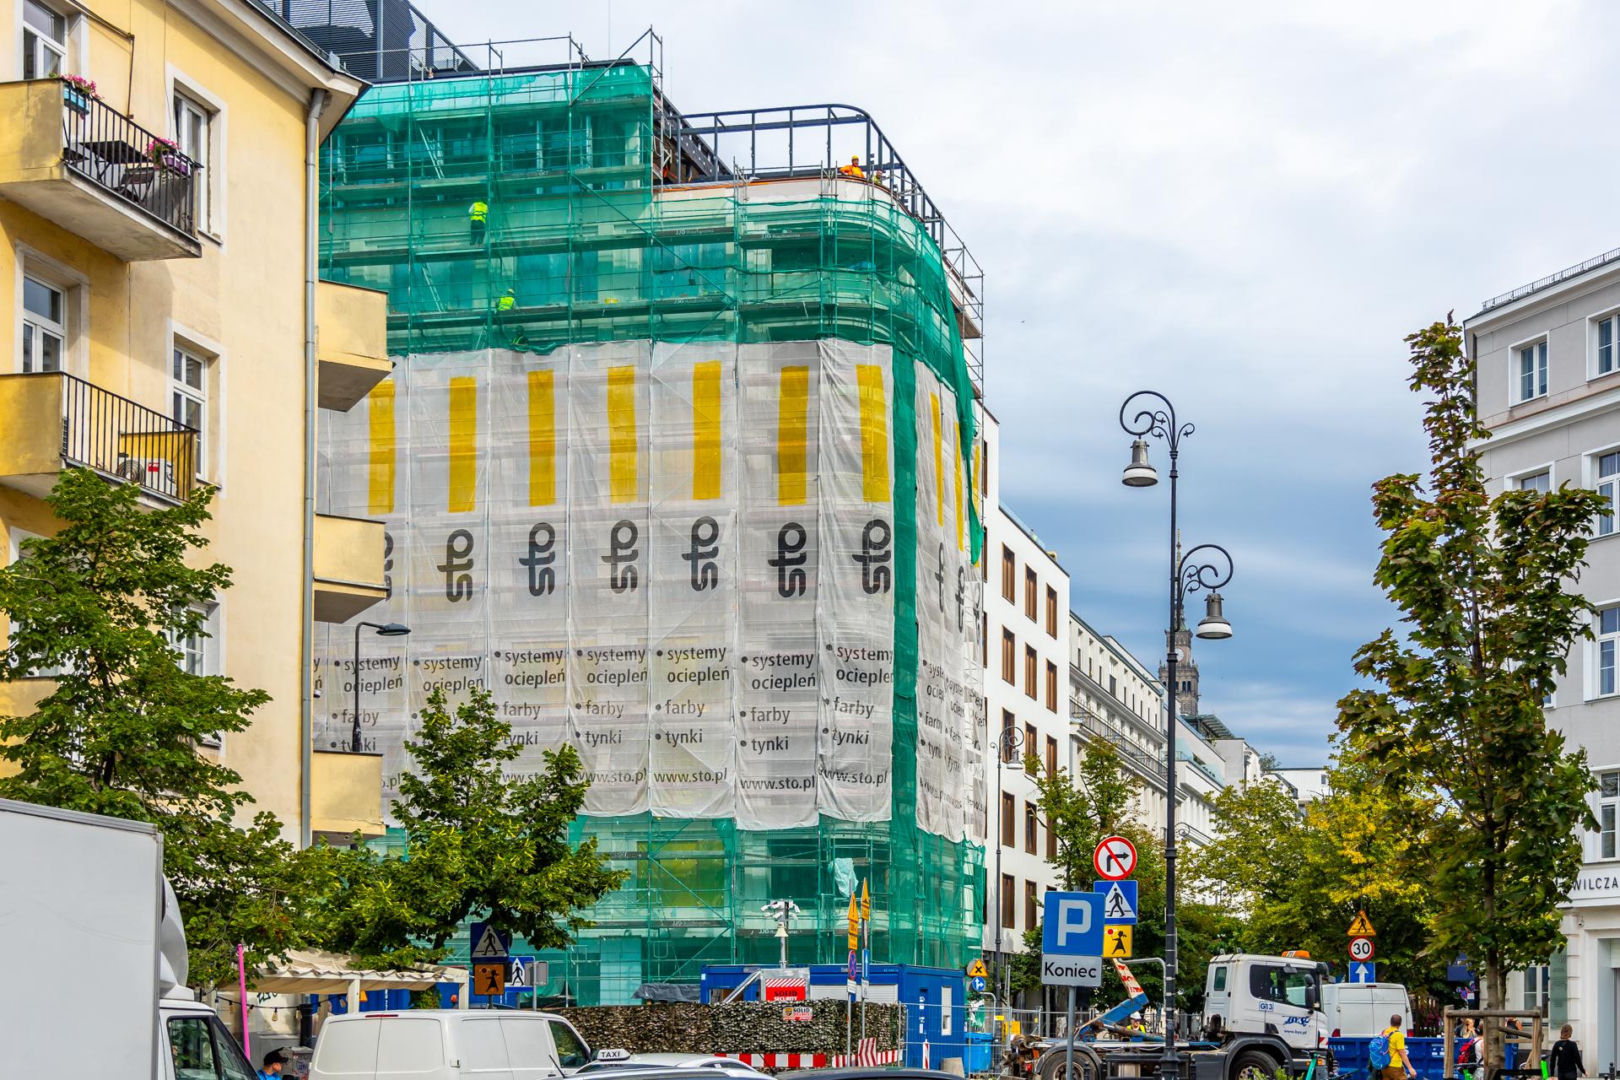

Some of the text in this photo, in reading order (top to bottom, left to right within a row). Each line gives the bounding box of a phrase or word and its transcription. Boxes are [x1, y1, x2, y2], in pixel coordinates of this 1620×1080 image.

[519, 522, 555, 596] sto
[601, 520, 638, 594] sto
[682, 516, 719, 591] sto
[768, 522, 807, 598] sto
[852, 519, 891, 595] sto
[437, 529, 474, 603] sto
[505, 650, 563, 667] systemy
[587, 648, 646, 665] systemy
[667, 647, 727, 664] systemy
[752, 653, 814, 671] systemy
[423, 656, 482, 675] systemy
[423, 675, 484, 694] ociepleń
[505, 669, 565, 688] ociepleń
[587, 667, 648, 687] ociepleń
[667, 666, 730, 686] ociepleń
[752, 673, 816, 692] ociepleń
[503, 701, 541, 719] farby
[585, 700, 624, 718] farby
[665, 699, 705, 717] farby
[751, 706, 791, 724] farby
[834, 696, 874, 719] farby
[585, 730, 622, 747] tynki
[665, 729, 703, 747] tynki
[752, 736, 789, 754] tynki
[832, 728, 869, 746] tynki
[654, 768, 727, 784] www.sto.pl
[740, 776, 815, 791] www.sto.pl
[818, 765, 887, 787] www.sto.pl
[1573, 876, 1619, 890] WILCZA
[1057, 899, 1092, 946] P
[1353, 942, 1370, 955] 30
[1044, 962, 1097, 978] Koniec
